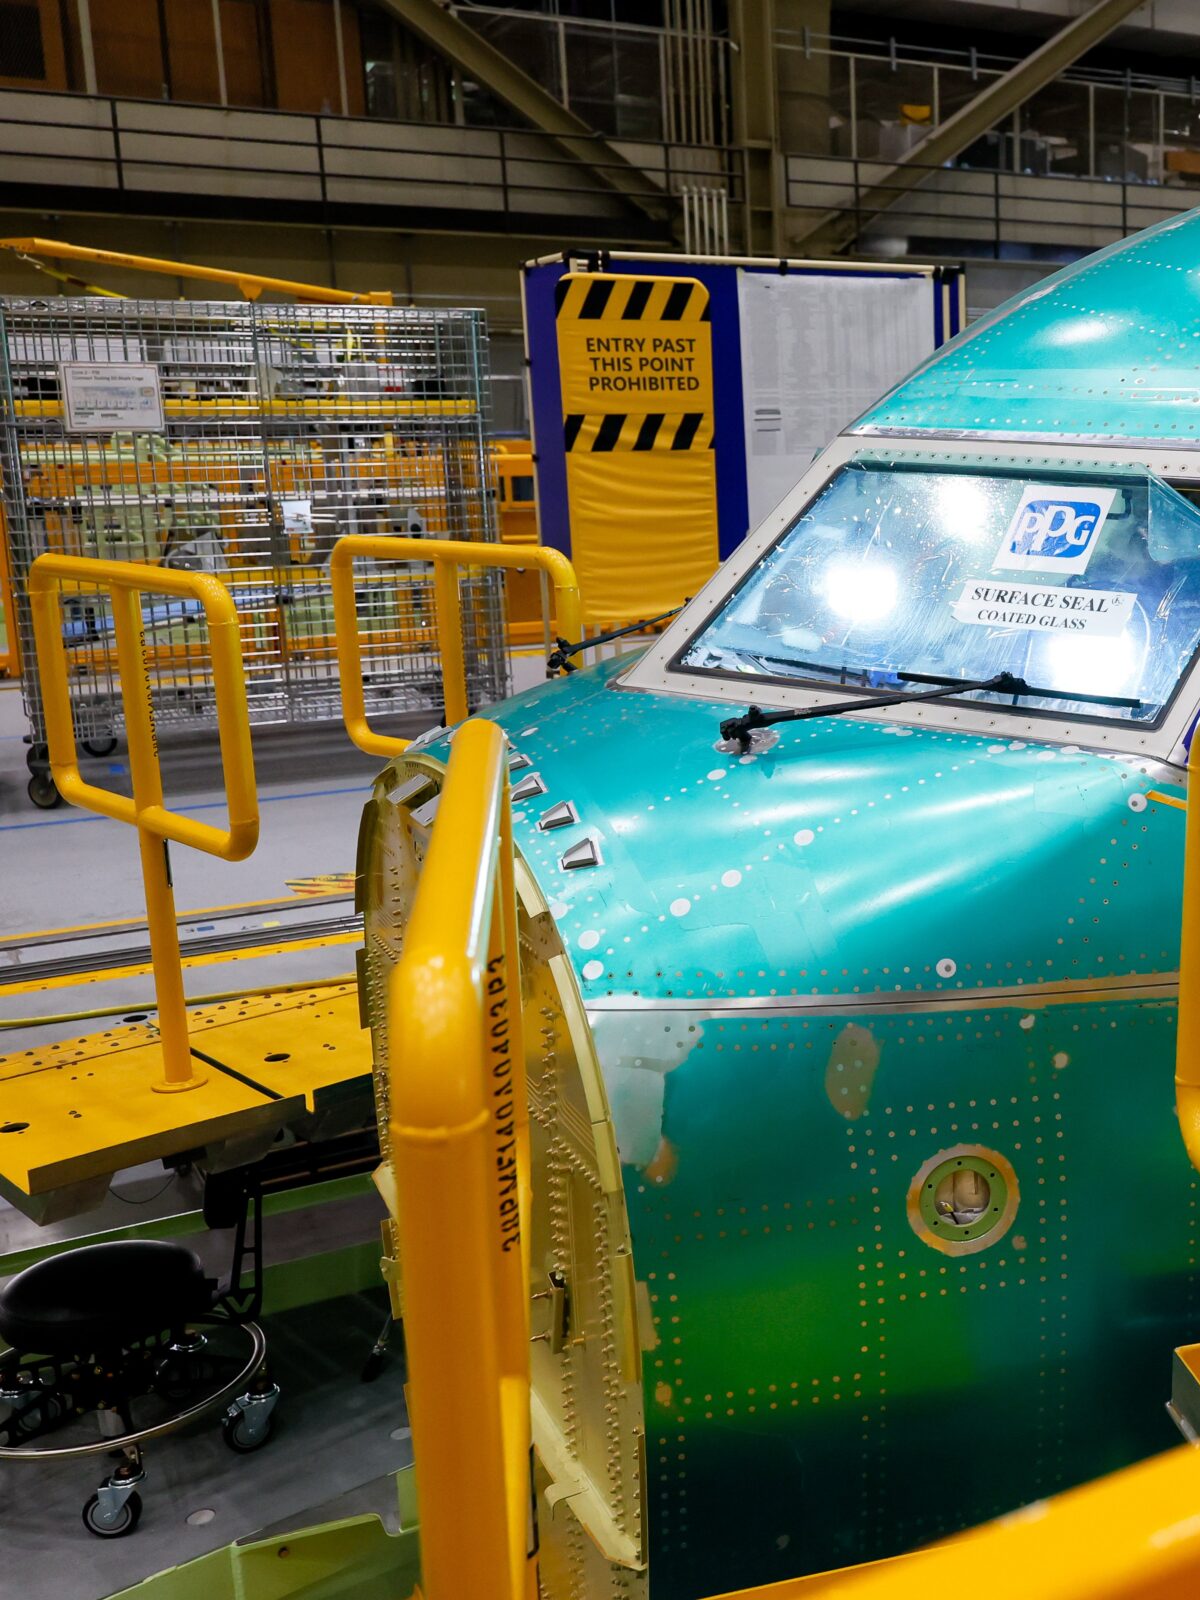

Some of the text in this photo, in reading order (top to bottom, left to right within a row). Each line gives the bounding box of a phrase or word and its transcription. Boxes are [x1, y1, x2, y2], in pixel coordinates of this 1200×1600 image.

[586, 337, 696, 352] ENTRY PAST
[589, 357, 695, 372] THIS POINT
[589, 376, 700, 391] PROHIBITED
[1013, 505, 1095, 553] PPG
[971, 586, 1057, 608] SURFACE
[977, 609, 1087, 630] COATED GLASS
